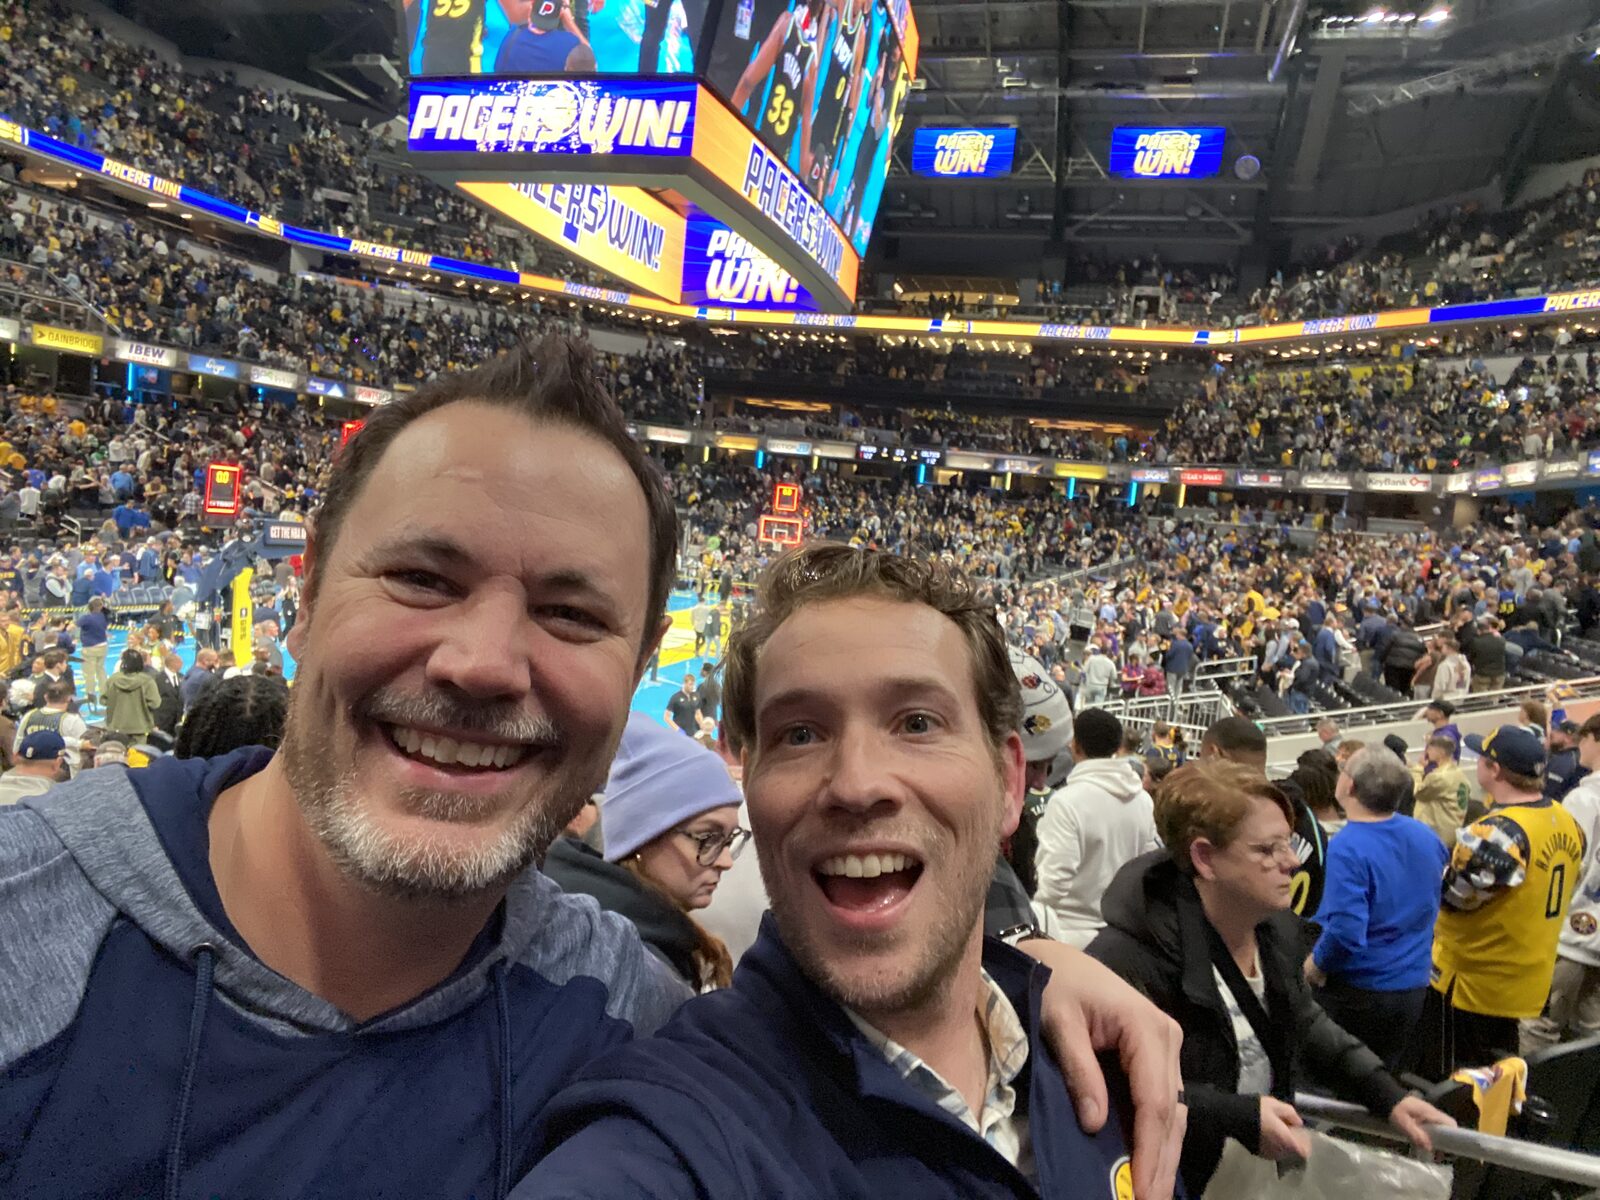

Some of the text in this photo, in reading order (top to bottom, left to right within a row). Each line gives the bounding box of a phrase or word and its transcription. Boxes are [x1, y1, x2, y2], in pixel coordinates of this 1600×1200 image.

[767, 84, 794, 136] 33
[578, 97, 691, 149] WIN!
[935, 133, 995, 151] PACERS
[1135, 133, 1201, 151] PACERS
[934, 149, 987, 174] WIN!
[1134, 149, 1195, 174] WIN!
[101, 158, 182, 199] PACERS WIN!
[742, 140, 817, 253] PACERS
[607, 199, 665, 272] WIN!
[350, 239, 433, 267] PACERS WIN!
[793, 313, 831, 326] PACERS
[1039, 323, 1112, 340] PACERS WIN!
[1301, 316, 1346, 335] PACERS
[47, 332, 100, 350] GAINBRIDGE
[128, 343, 165, 359] IBEW
[1545, 863, 1566, 919] 0
